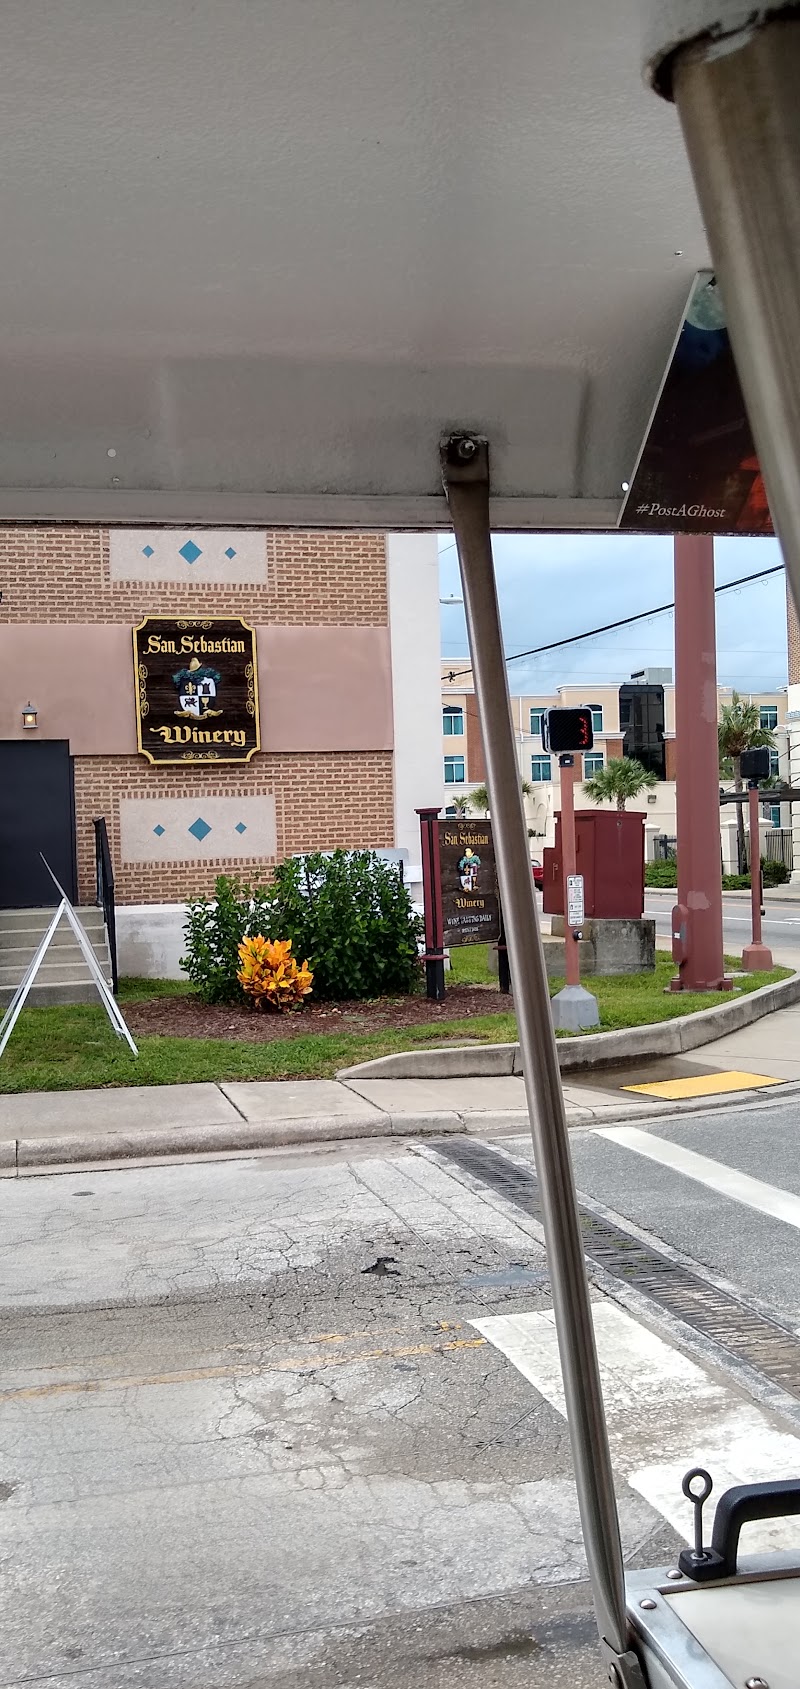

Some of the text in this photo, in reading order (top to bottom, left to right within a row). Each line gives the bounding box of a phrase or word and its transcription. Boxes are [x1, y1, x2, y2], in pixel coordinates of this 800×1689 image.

[635, 502, 726, 518] #PostAGhost
[143, 635, 246, 655] San Sebastian
[149, 725, 246, 747] Winery
[441, 831, 489, 847] San Sebastian
[453, 897, 485, 909] Winery
